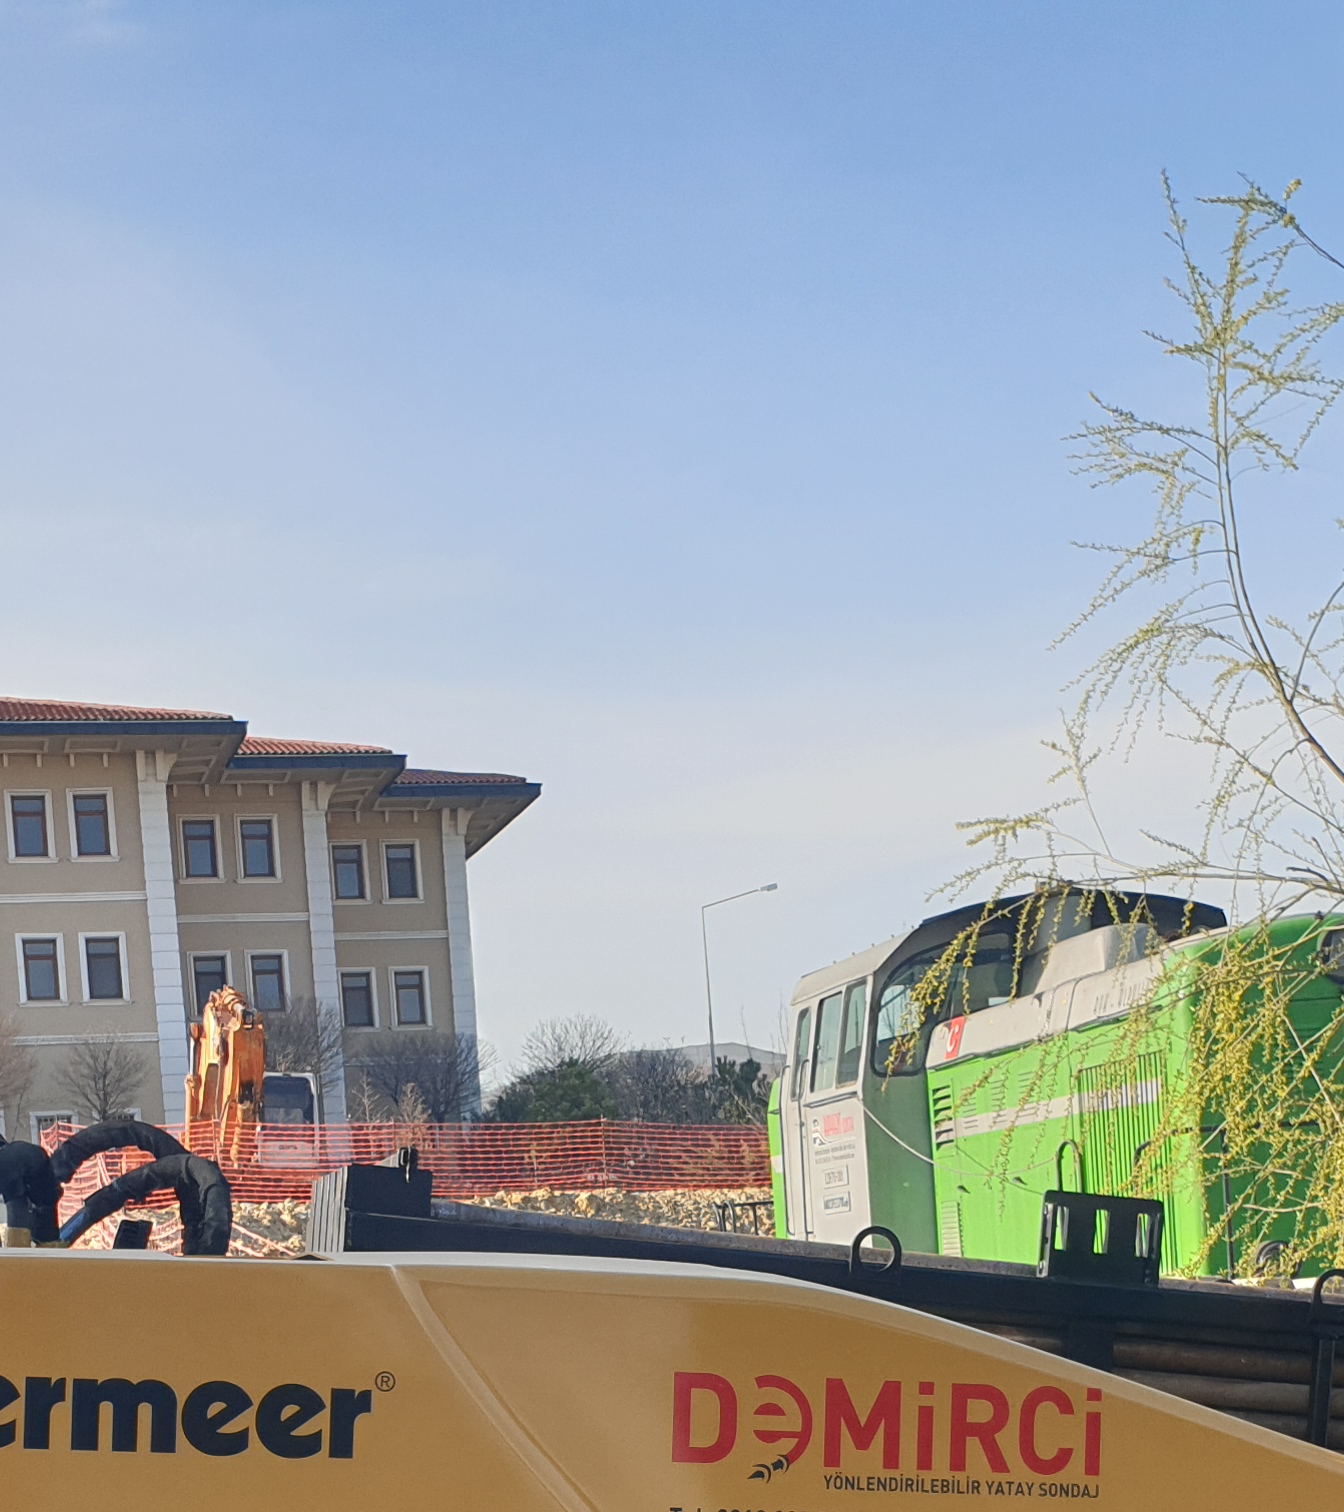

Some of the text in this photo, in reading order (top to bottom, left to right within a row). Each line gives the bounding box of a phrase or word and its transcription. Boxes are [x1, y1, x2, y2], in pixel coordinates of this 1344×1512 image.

[823, 1471, 1100, 1499] YÖNLENDİRİLEBİLİR YATAY SONDAJ
